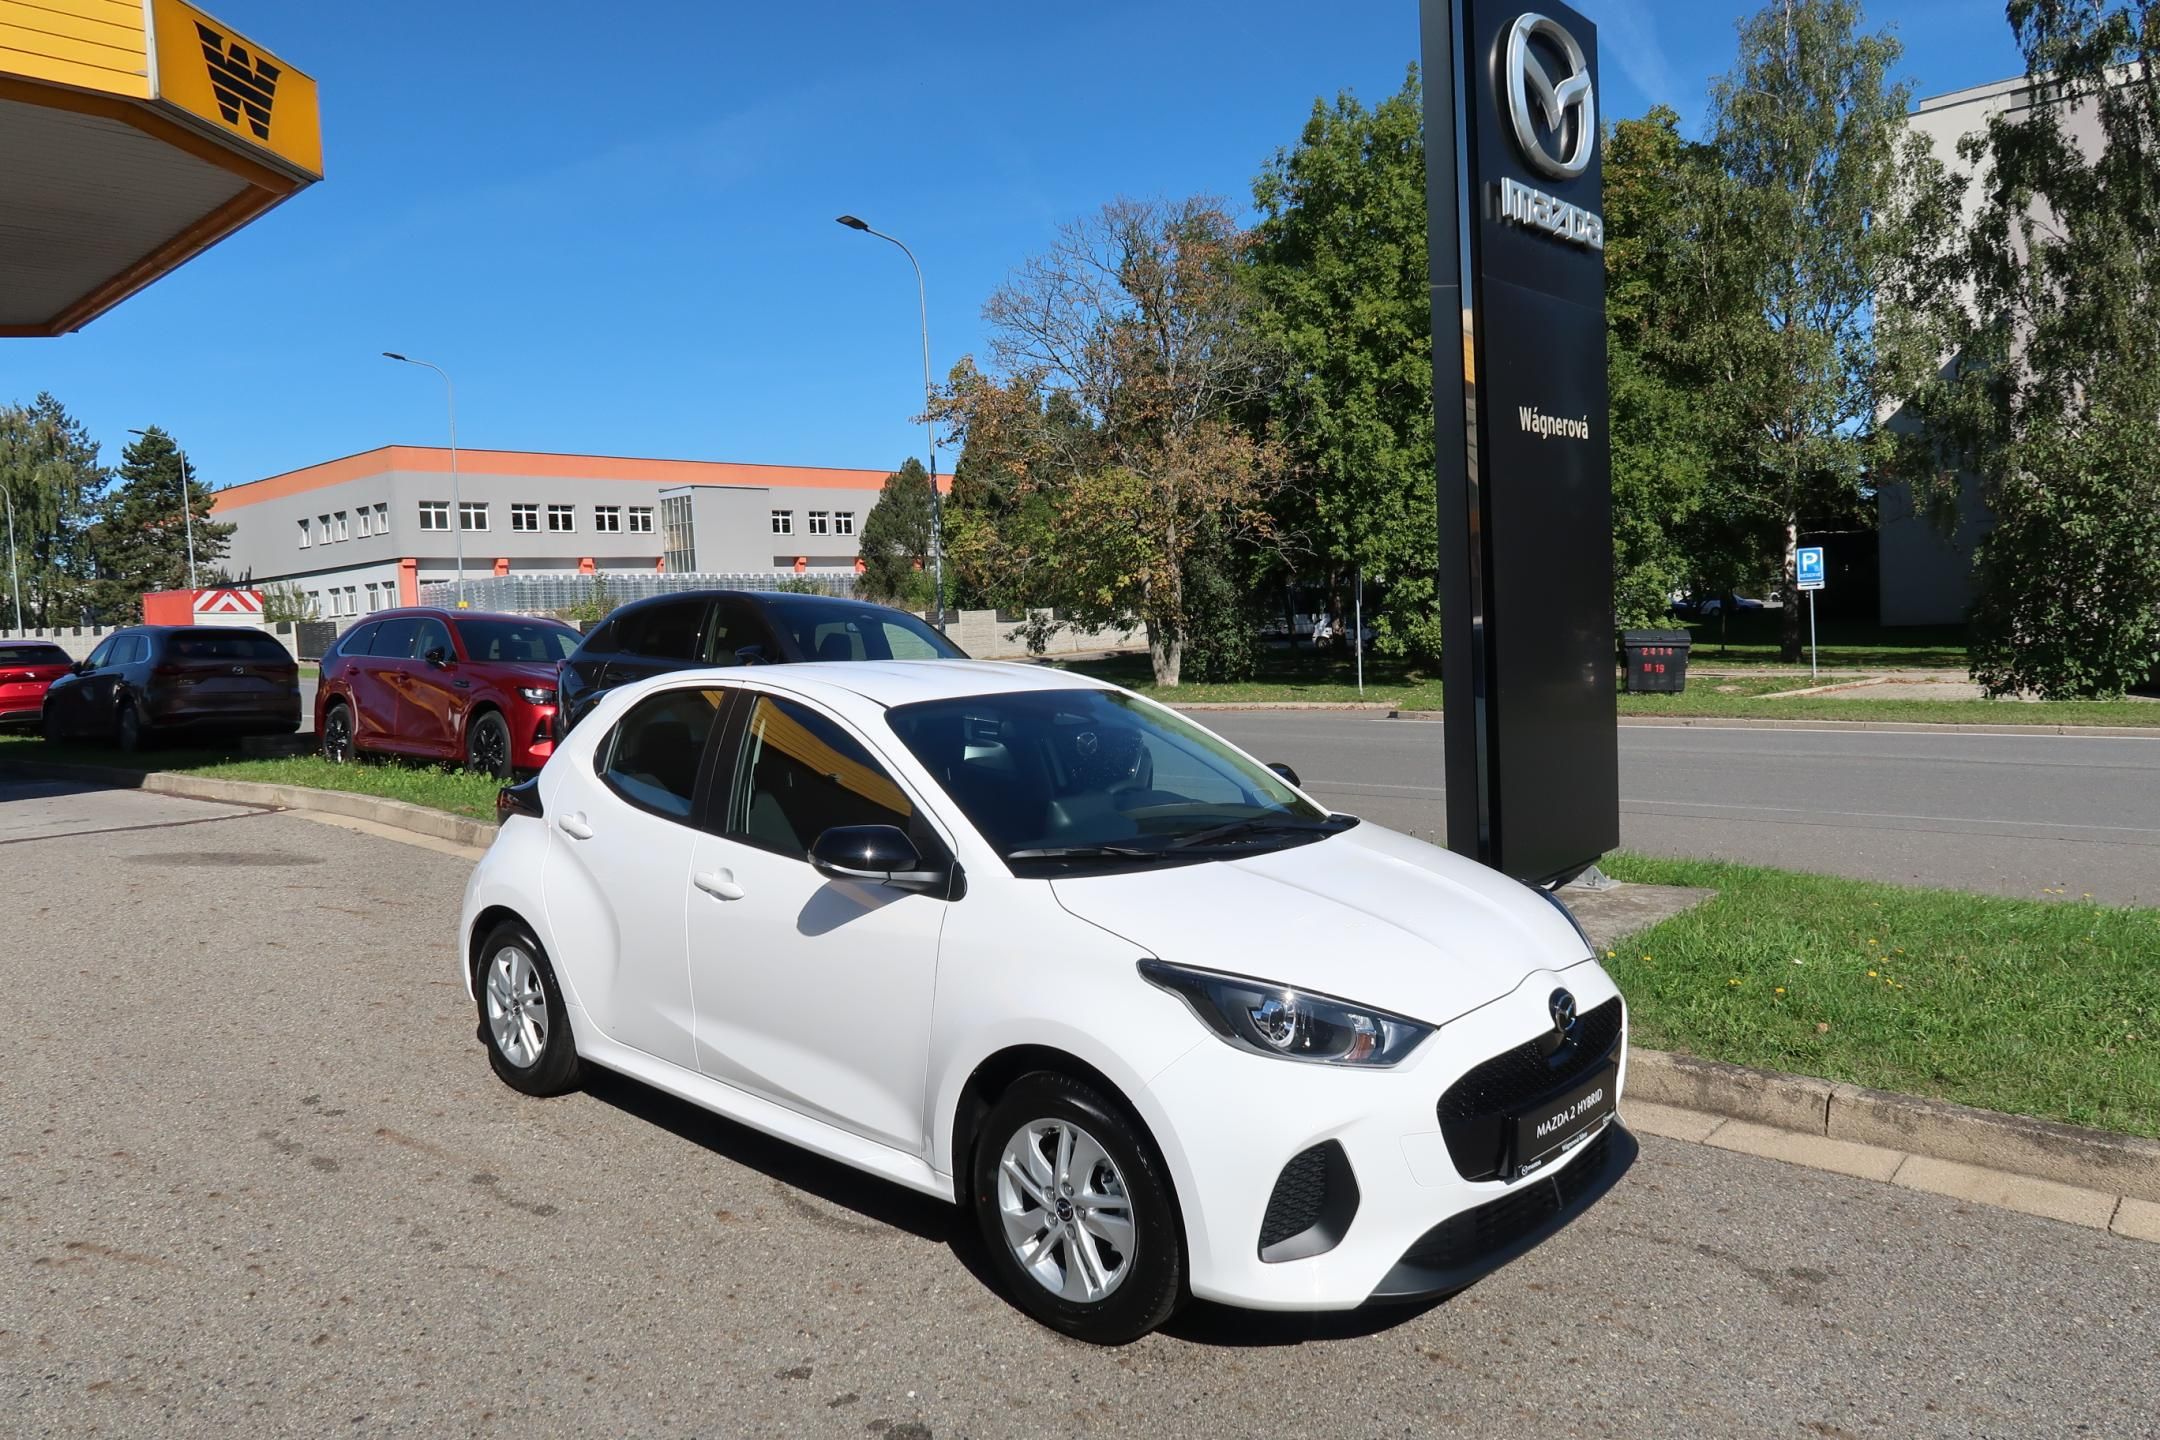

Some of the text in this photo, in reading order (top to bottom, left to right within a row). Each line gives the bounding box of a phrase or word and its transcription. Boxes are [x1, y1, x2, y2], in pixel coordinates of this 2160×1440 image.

[1501, 177, 1603, 250] mazda
[1519, 406, 1588, 440] Wágnerová
[1802, 552, 1818, 572] P
[1536, 1110, 1569, 1139] MAZDA
[1569, 1105, 1576, 1120] 2
[1577, 1088, 1603, 1115] HYBRID
